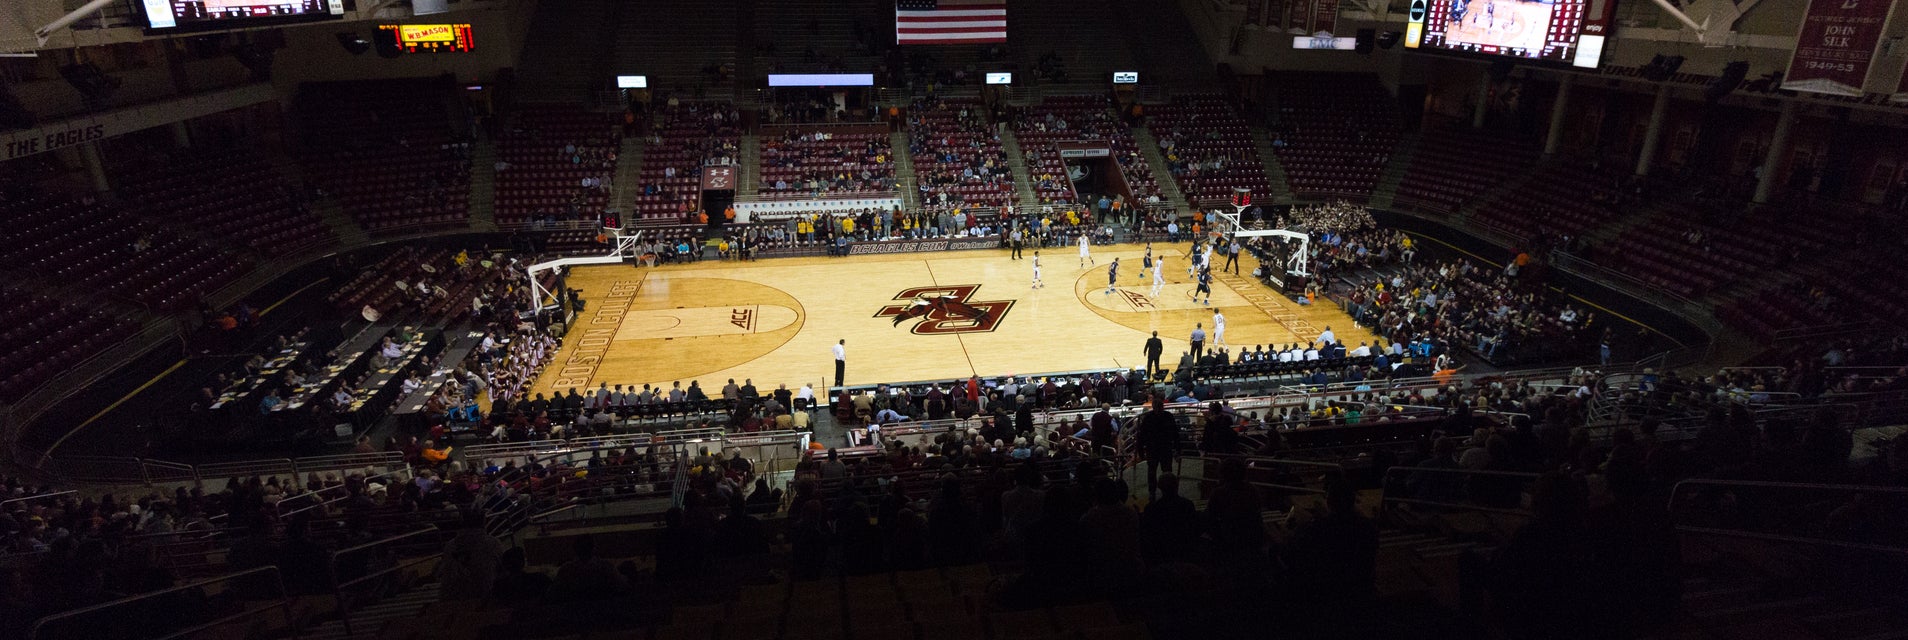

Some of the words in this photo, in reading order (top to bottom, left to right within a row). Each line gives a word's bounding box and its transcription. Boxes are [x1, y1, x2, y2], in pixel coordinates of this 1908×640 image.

[1586, 24, 1603, 32] enjoy
[1823, 25, 1856, 36] JOHN
[1822, 36, 1851, 47] SILK
[6, 137, 39, 158] THE
[45, 124, 103, 150] EAGLES
[730, 308, 748, 329] ACC
[551, 326, 618, 388] BOSTON
[591, 279, 643, 325] COLLEGE
